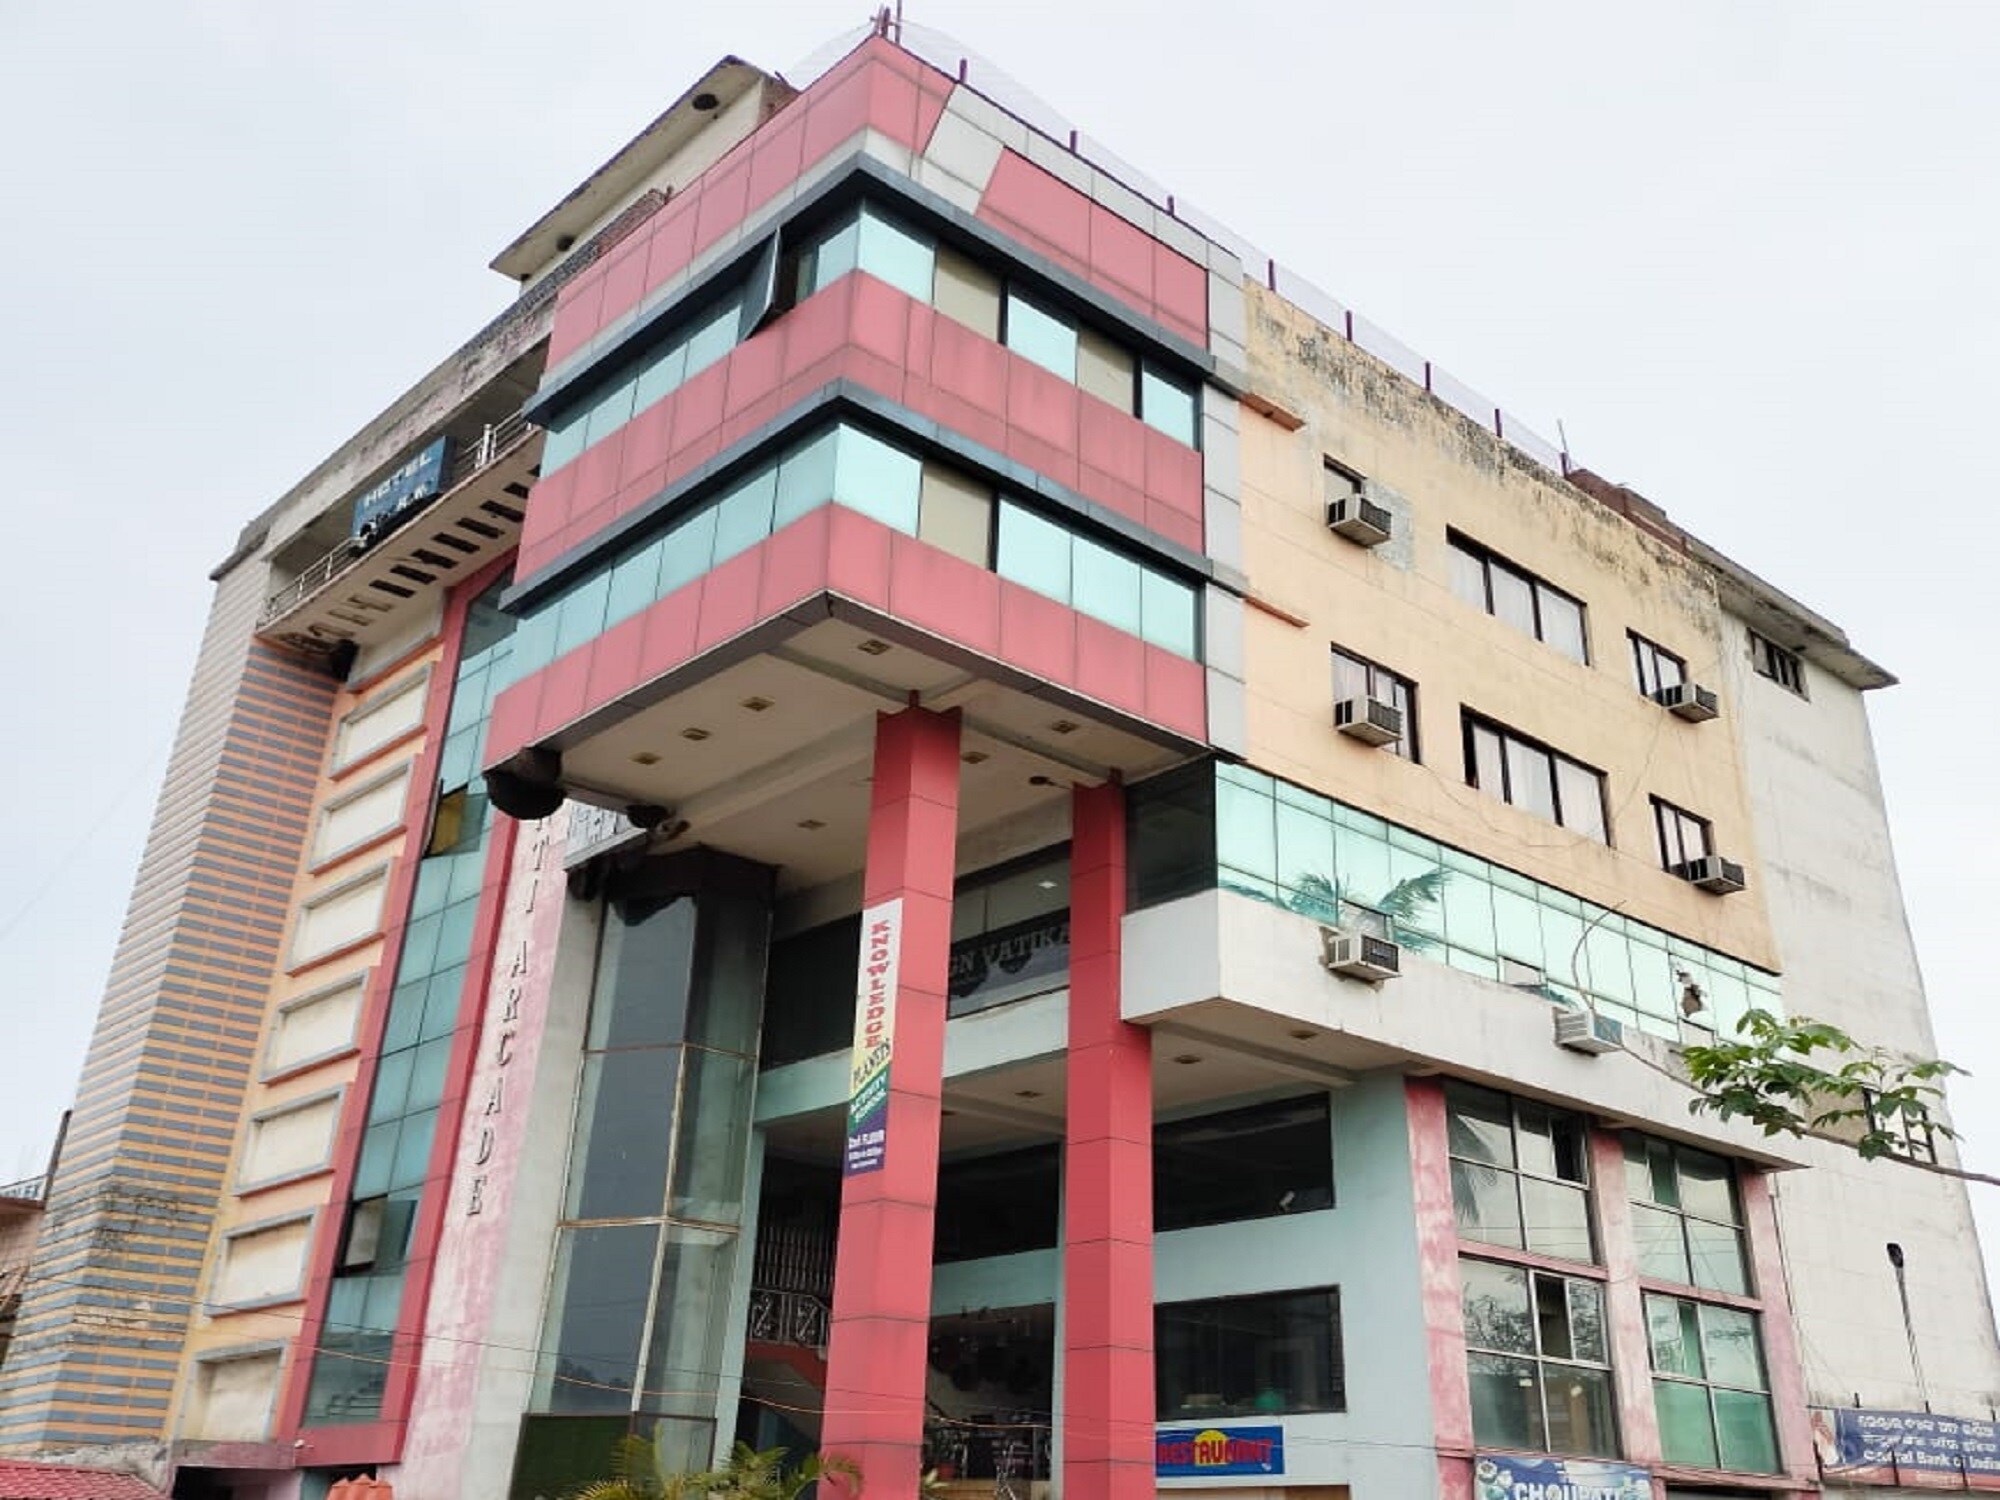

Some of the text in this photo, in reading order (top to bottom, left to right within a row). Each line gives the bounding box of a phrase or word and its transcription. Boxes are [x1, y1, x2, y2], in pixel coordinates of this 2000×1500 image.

[864, 919, 891, 1049] KNOWLEDGE
[465, 940, 528, 1218] ARCADE
[1916, 1451, 1949, 1467] Bank
